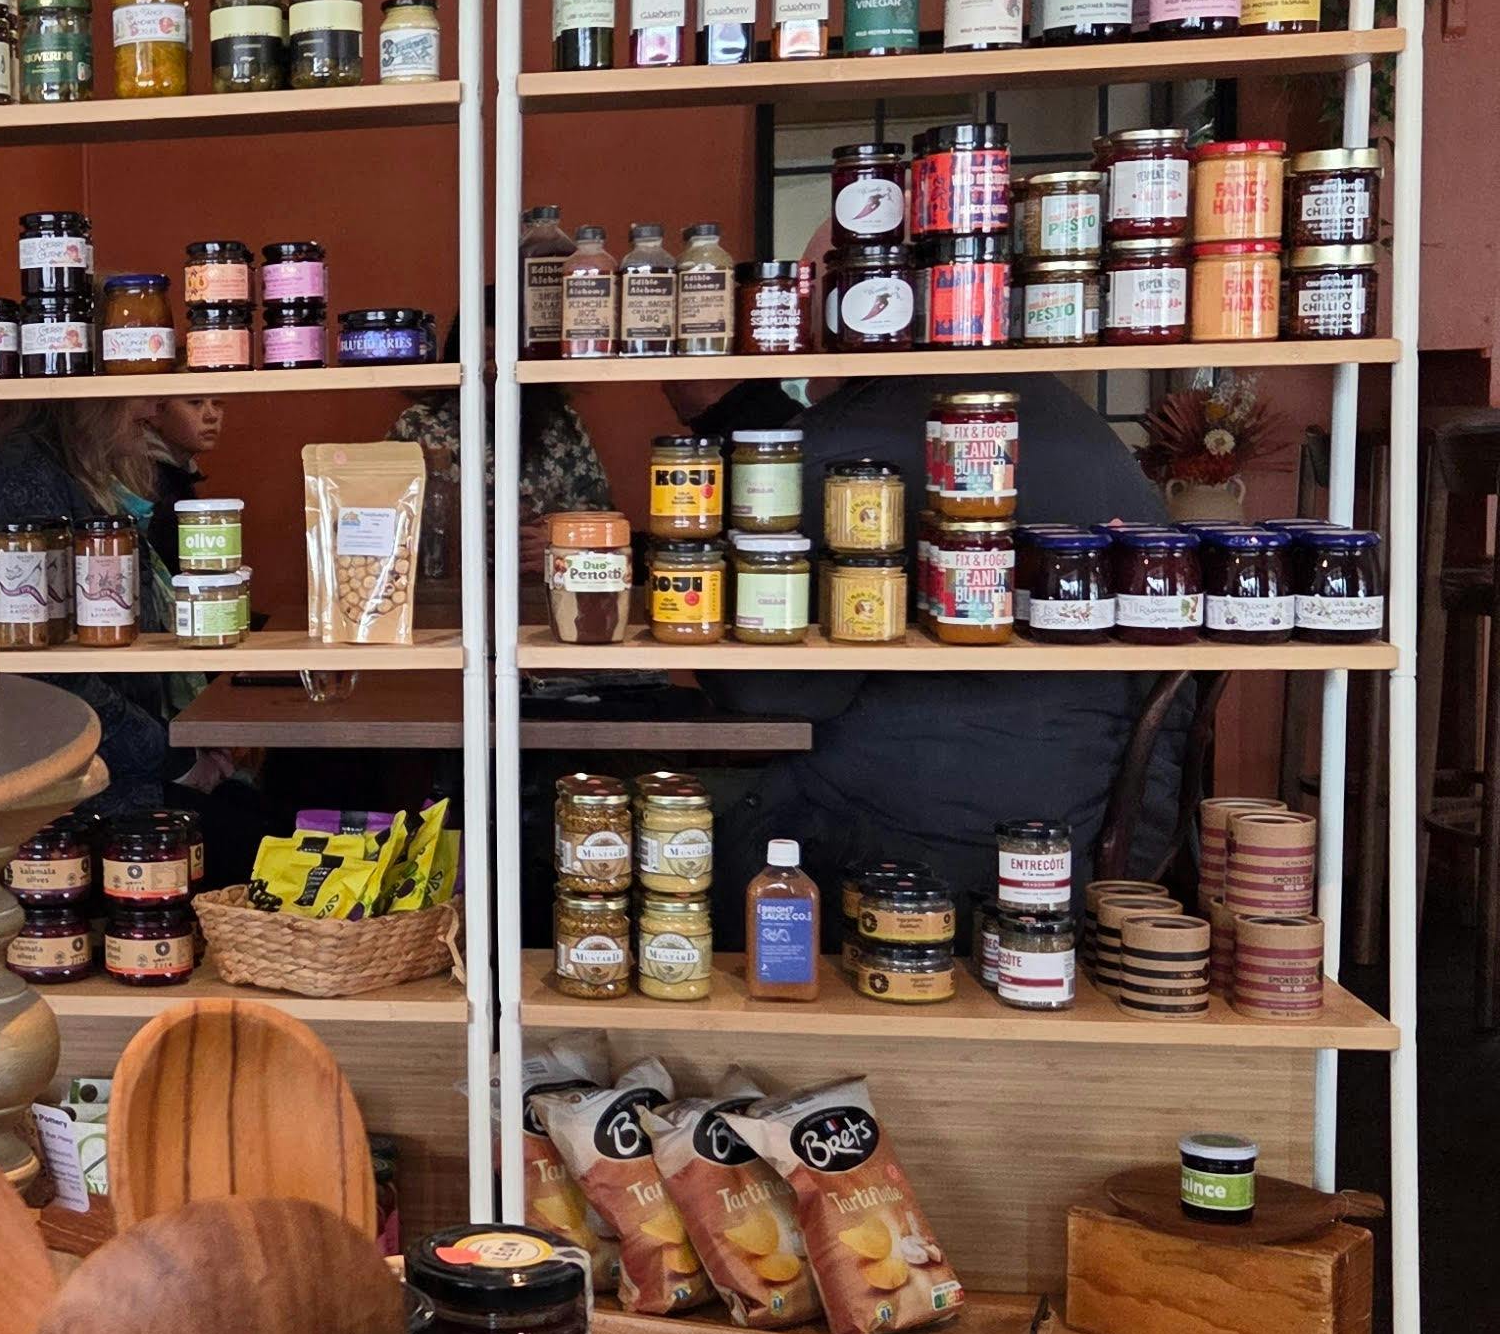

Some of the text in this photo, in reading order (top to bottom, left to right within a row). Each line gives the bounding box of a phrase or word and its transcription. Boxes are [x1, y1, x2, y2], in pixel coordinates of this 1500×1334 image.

[1076, 2, 1104, 11] MOTHER
[1214, 181, 1269, 198] FANCY
[1314, 196, 1356, 207] CRISPY
[1225, 280, 1274, 295] FANCY
[568, 300, 609, 308] KIMCHI
[1310, 292, 1353, 302] CRISPY
[1027, 302, 1076, 324] PESTO
[1302, 301, 1338, 313] CHILLI
[954, 424, 1007, 439] FIX & FOGG
[953, 441, 1007, 459] PEANUT
[655, 468, 716, 487] KOJI
[184, 532, 227, 549] olive
[583, 559, 608, 570] Duo
[954, 552, 1008, 567] FIX & FOGG
[954, 568, 1007, 586] PEANUT
[954, 585, 1007, 603] BUTTER
[1011, 857, 1065, 871] ENTRECÔTE
[26, 876, 50, 884] olives
[800, 1114, 872, 1169] Brets
[1181, 1177, 1227, 1199] uince
